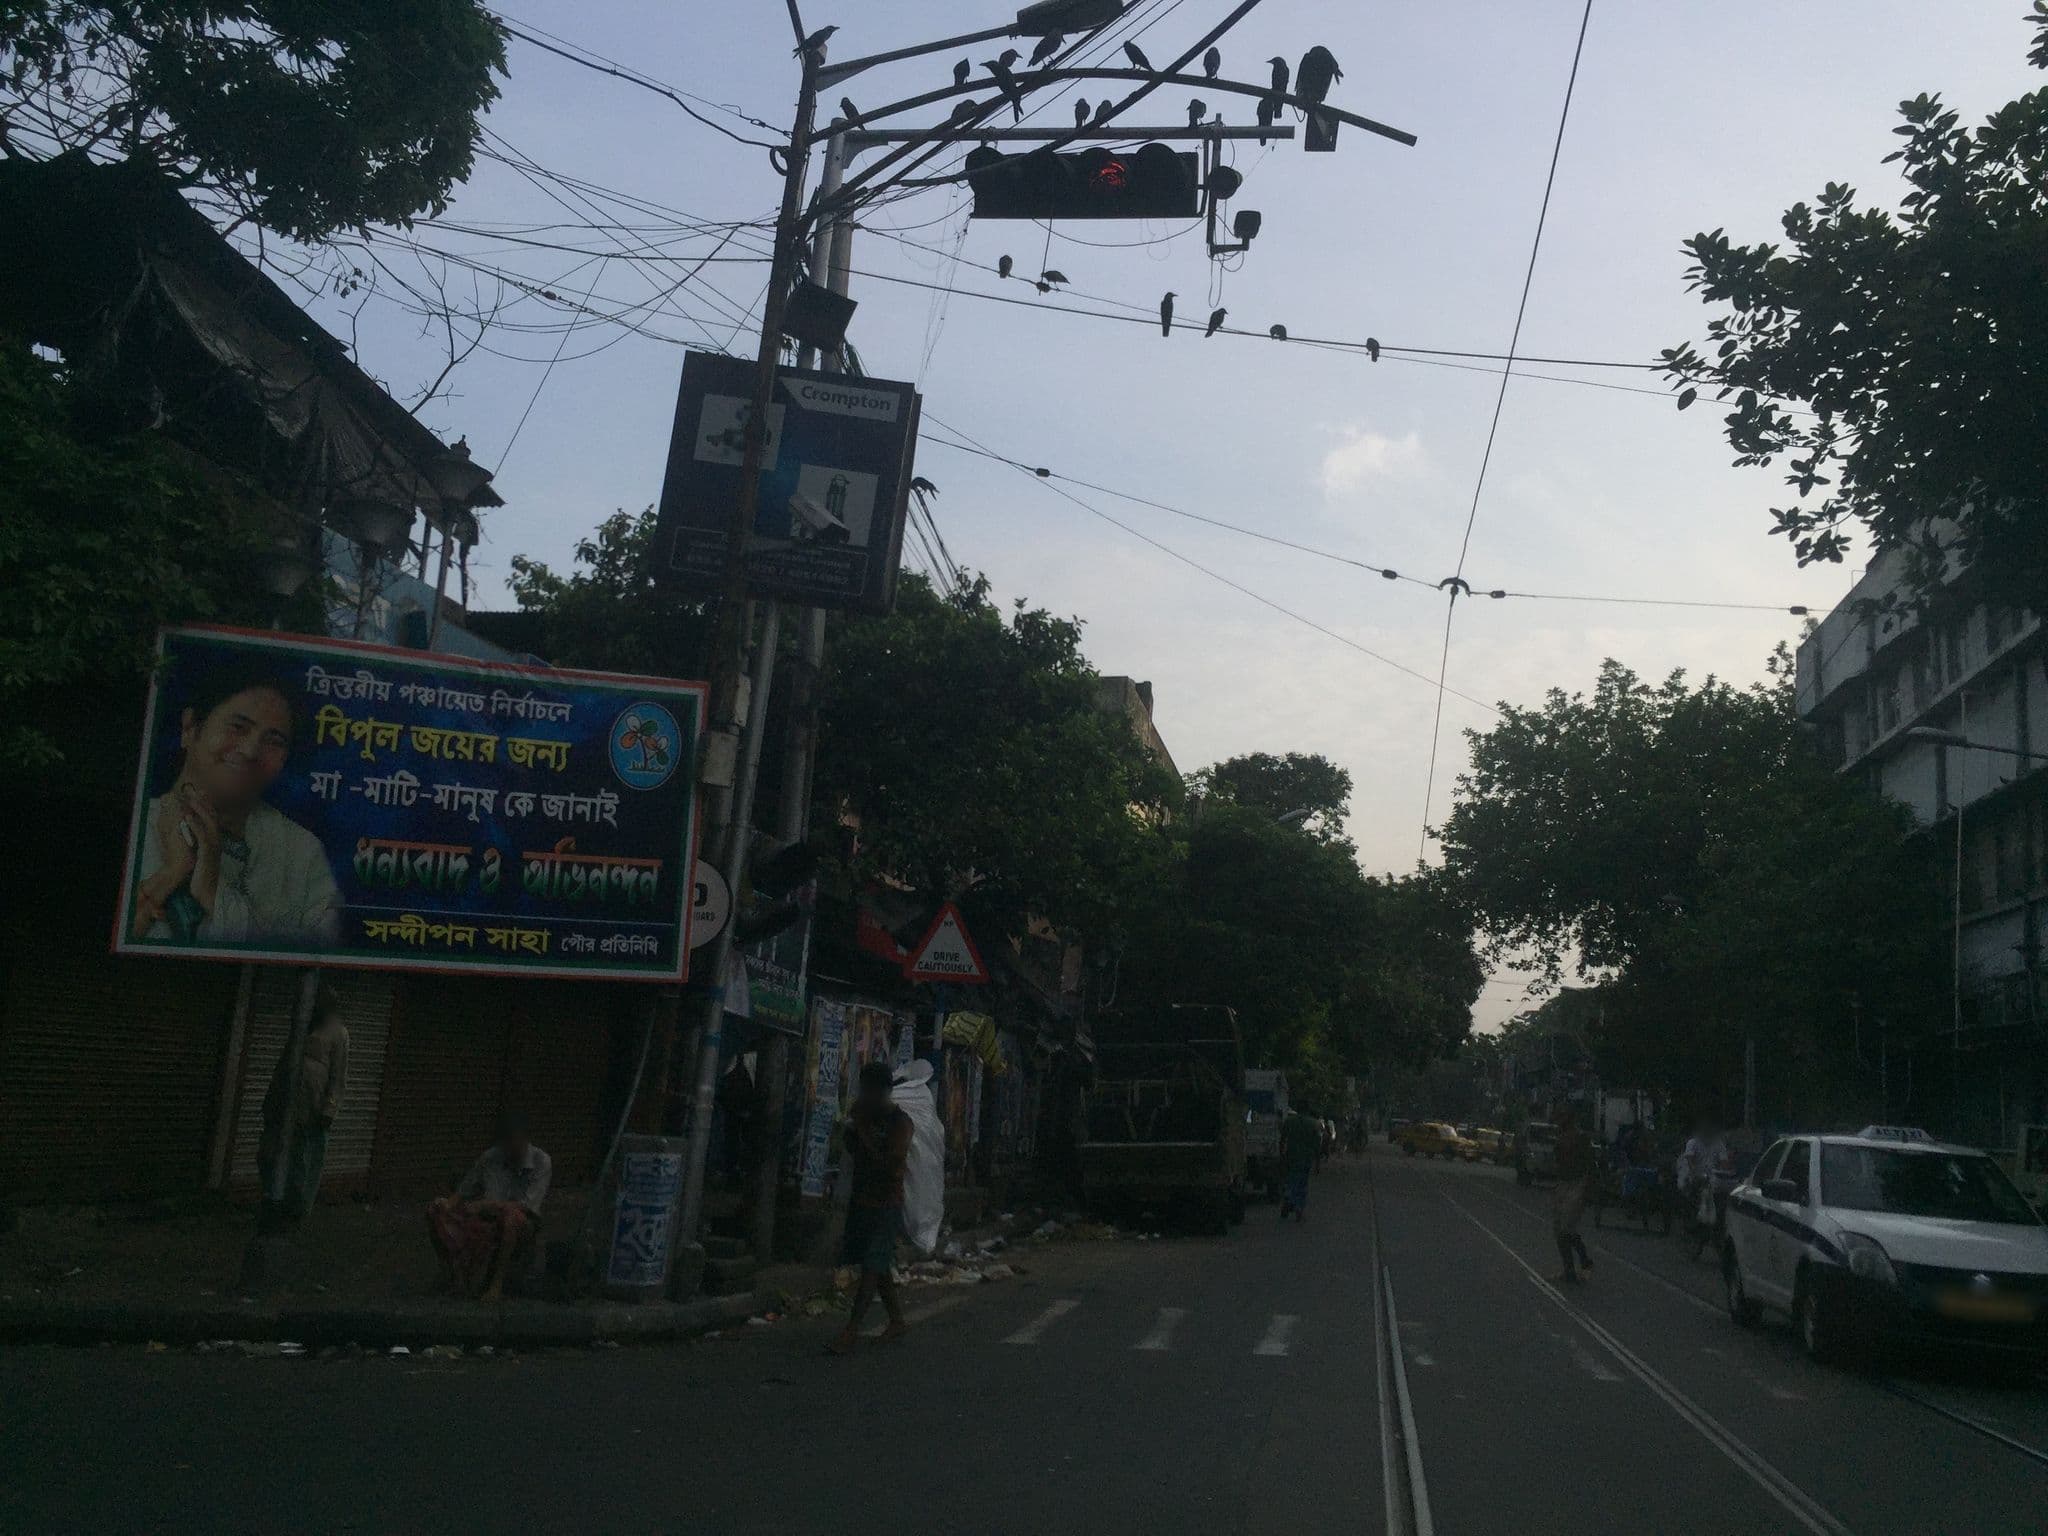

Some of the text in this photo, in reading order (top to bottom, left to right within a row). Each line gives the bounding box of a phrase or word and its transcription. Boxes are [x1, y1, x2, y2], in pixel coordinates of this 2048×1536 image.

[802, 386, 891, 411] Crompton
[490, 689, 573, 723] নির্বাচনে
[410, 725, 500, 764] জয়ের
[506, 736, 573, 774] জন্য
[310, 770, 343, 800] মা
[504, 791, 537, 818] কে
[541, 787, 620, 830] জানাই
[353, 835, 664, 902] ধন্যবাদ ও অভিনন্দন
[362, 913, 479, 948] সন্দীপন
[483, 926, 552, 955] সাহা
[599, 934, 660, 956] প্রতিনিধি
[918, 961, 974, 973] CAUTIOUSLY
[933, 951, 960, 962] DRIVE
